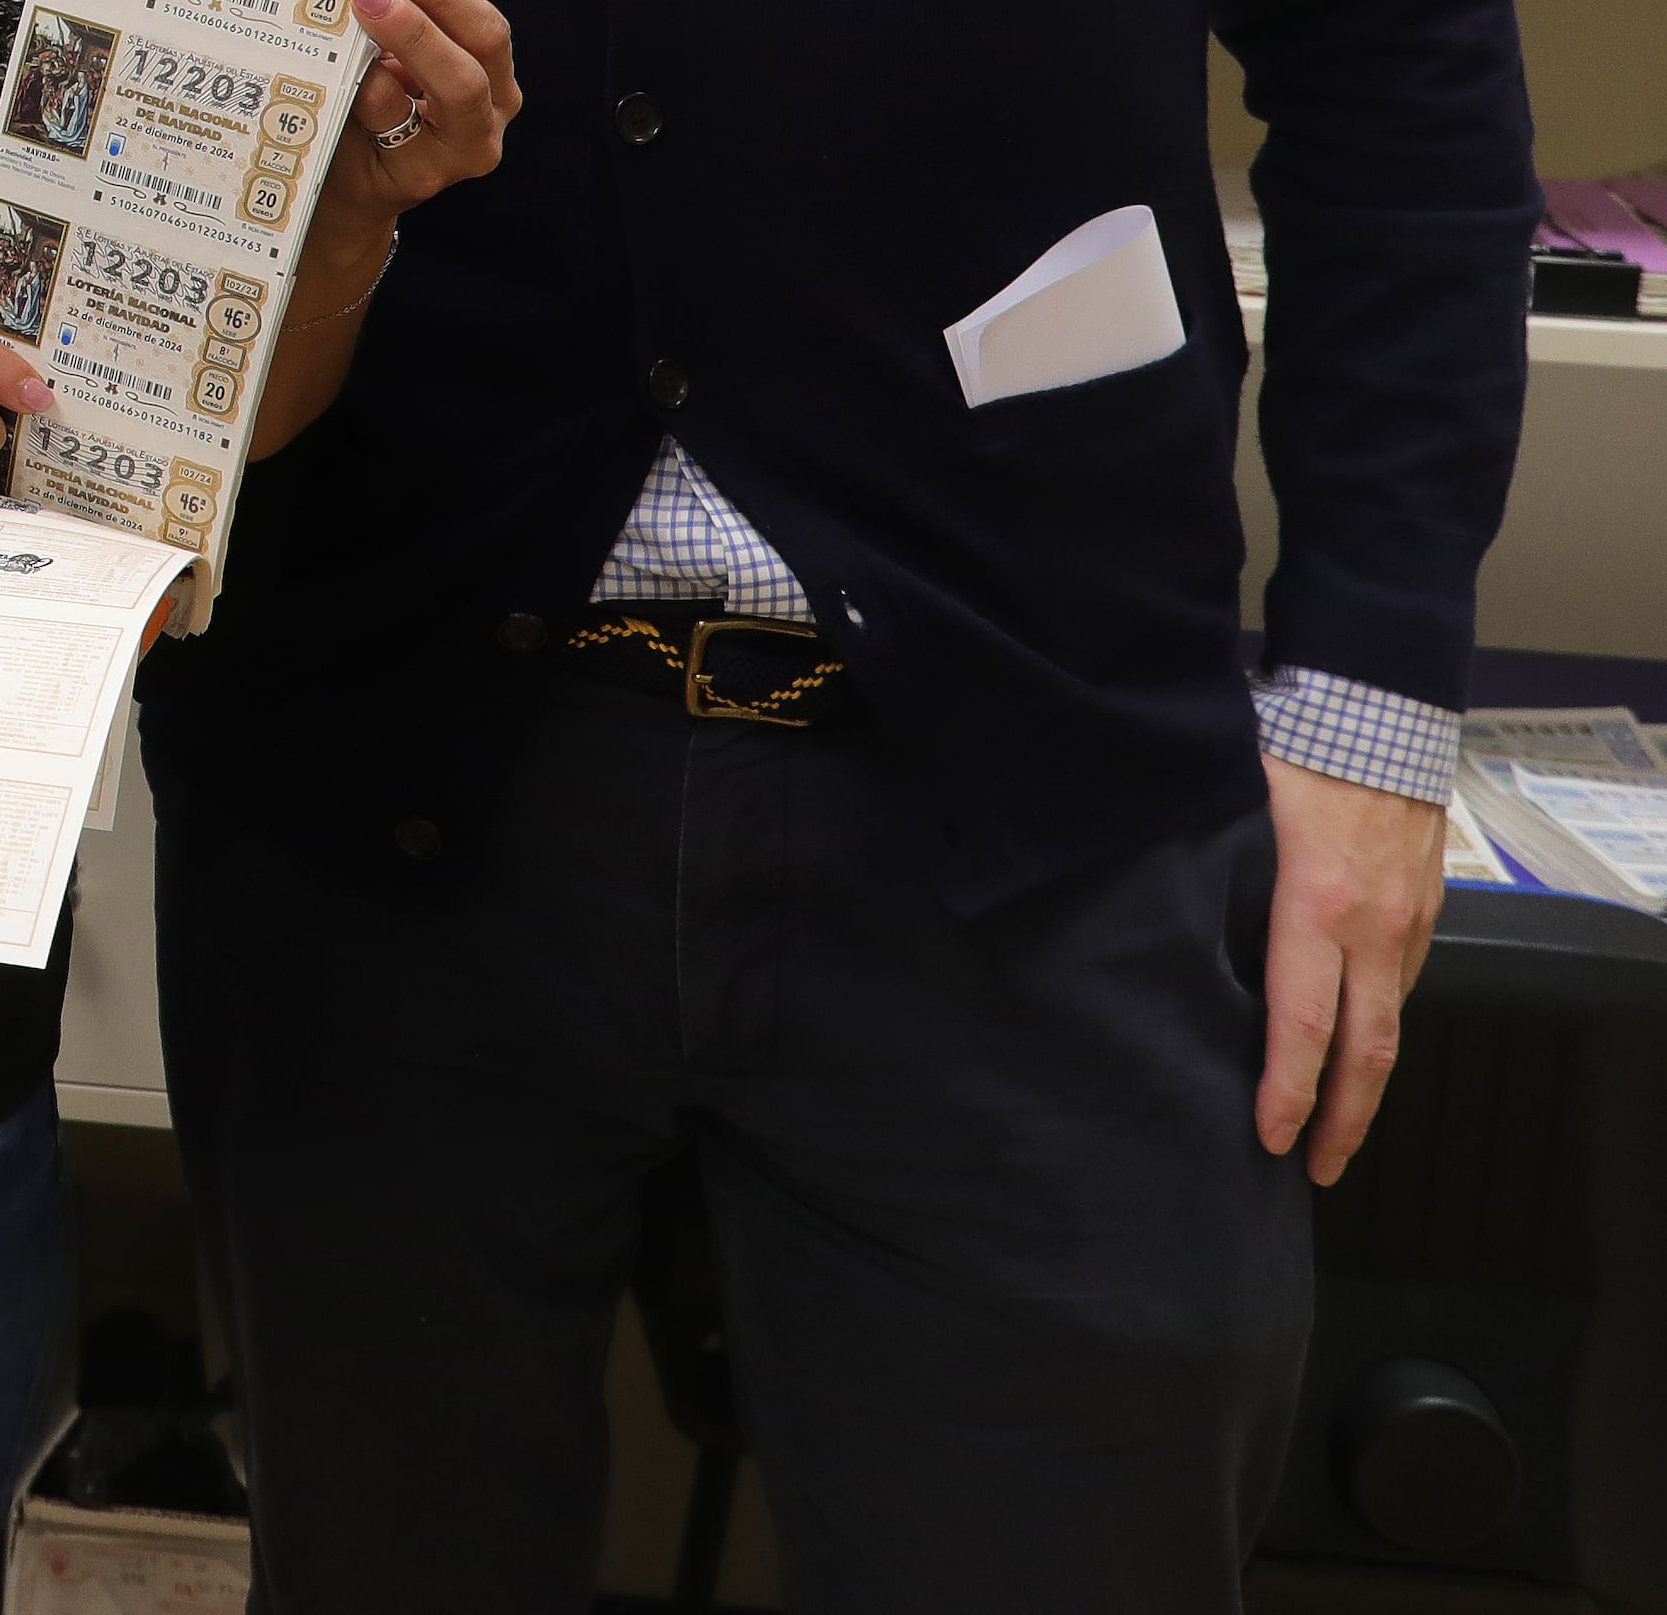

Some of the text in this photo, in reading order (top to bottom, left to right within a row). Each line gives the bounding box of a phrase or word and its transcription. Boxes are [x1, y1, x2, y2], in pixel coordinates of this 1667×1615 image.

[310, 11, 332, 23] EUROS
[133, 49, 263, 110] 12203
[116, 86, 250, 135] LOTERÍA NACIONAL
[135, 108, 223, 142] DE NAVIDAD
[255, 189, 277, 209] 20
[83, 241, 208, 304] 12203
[67, 276, 197, 328] LOTERÍA NACIONAL
[86, 298, 171, 334] DE NAVIDAD
[38, 427, 163, 488] 12203
